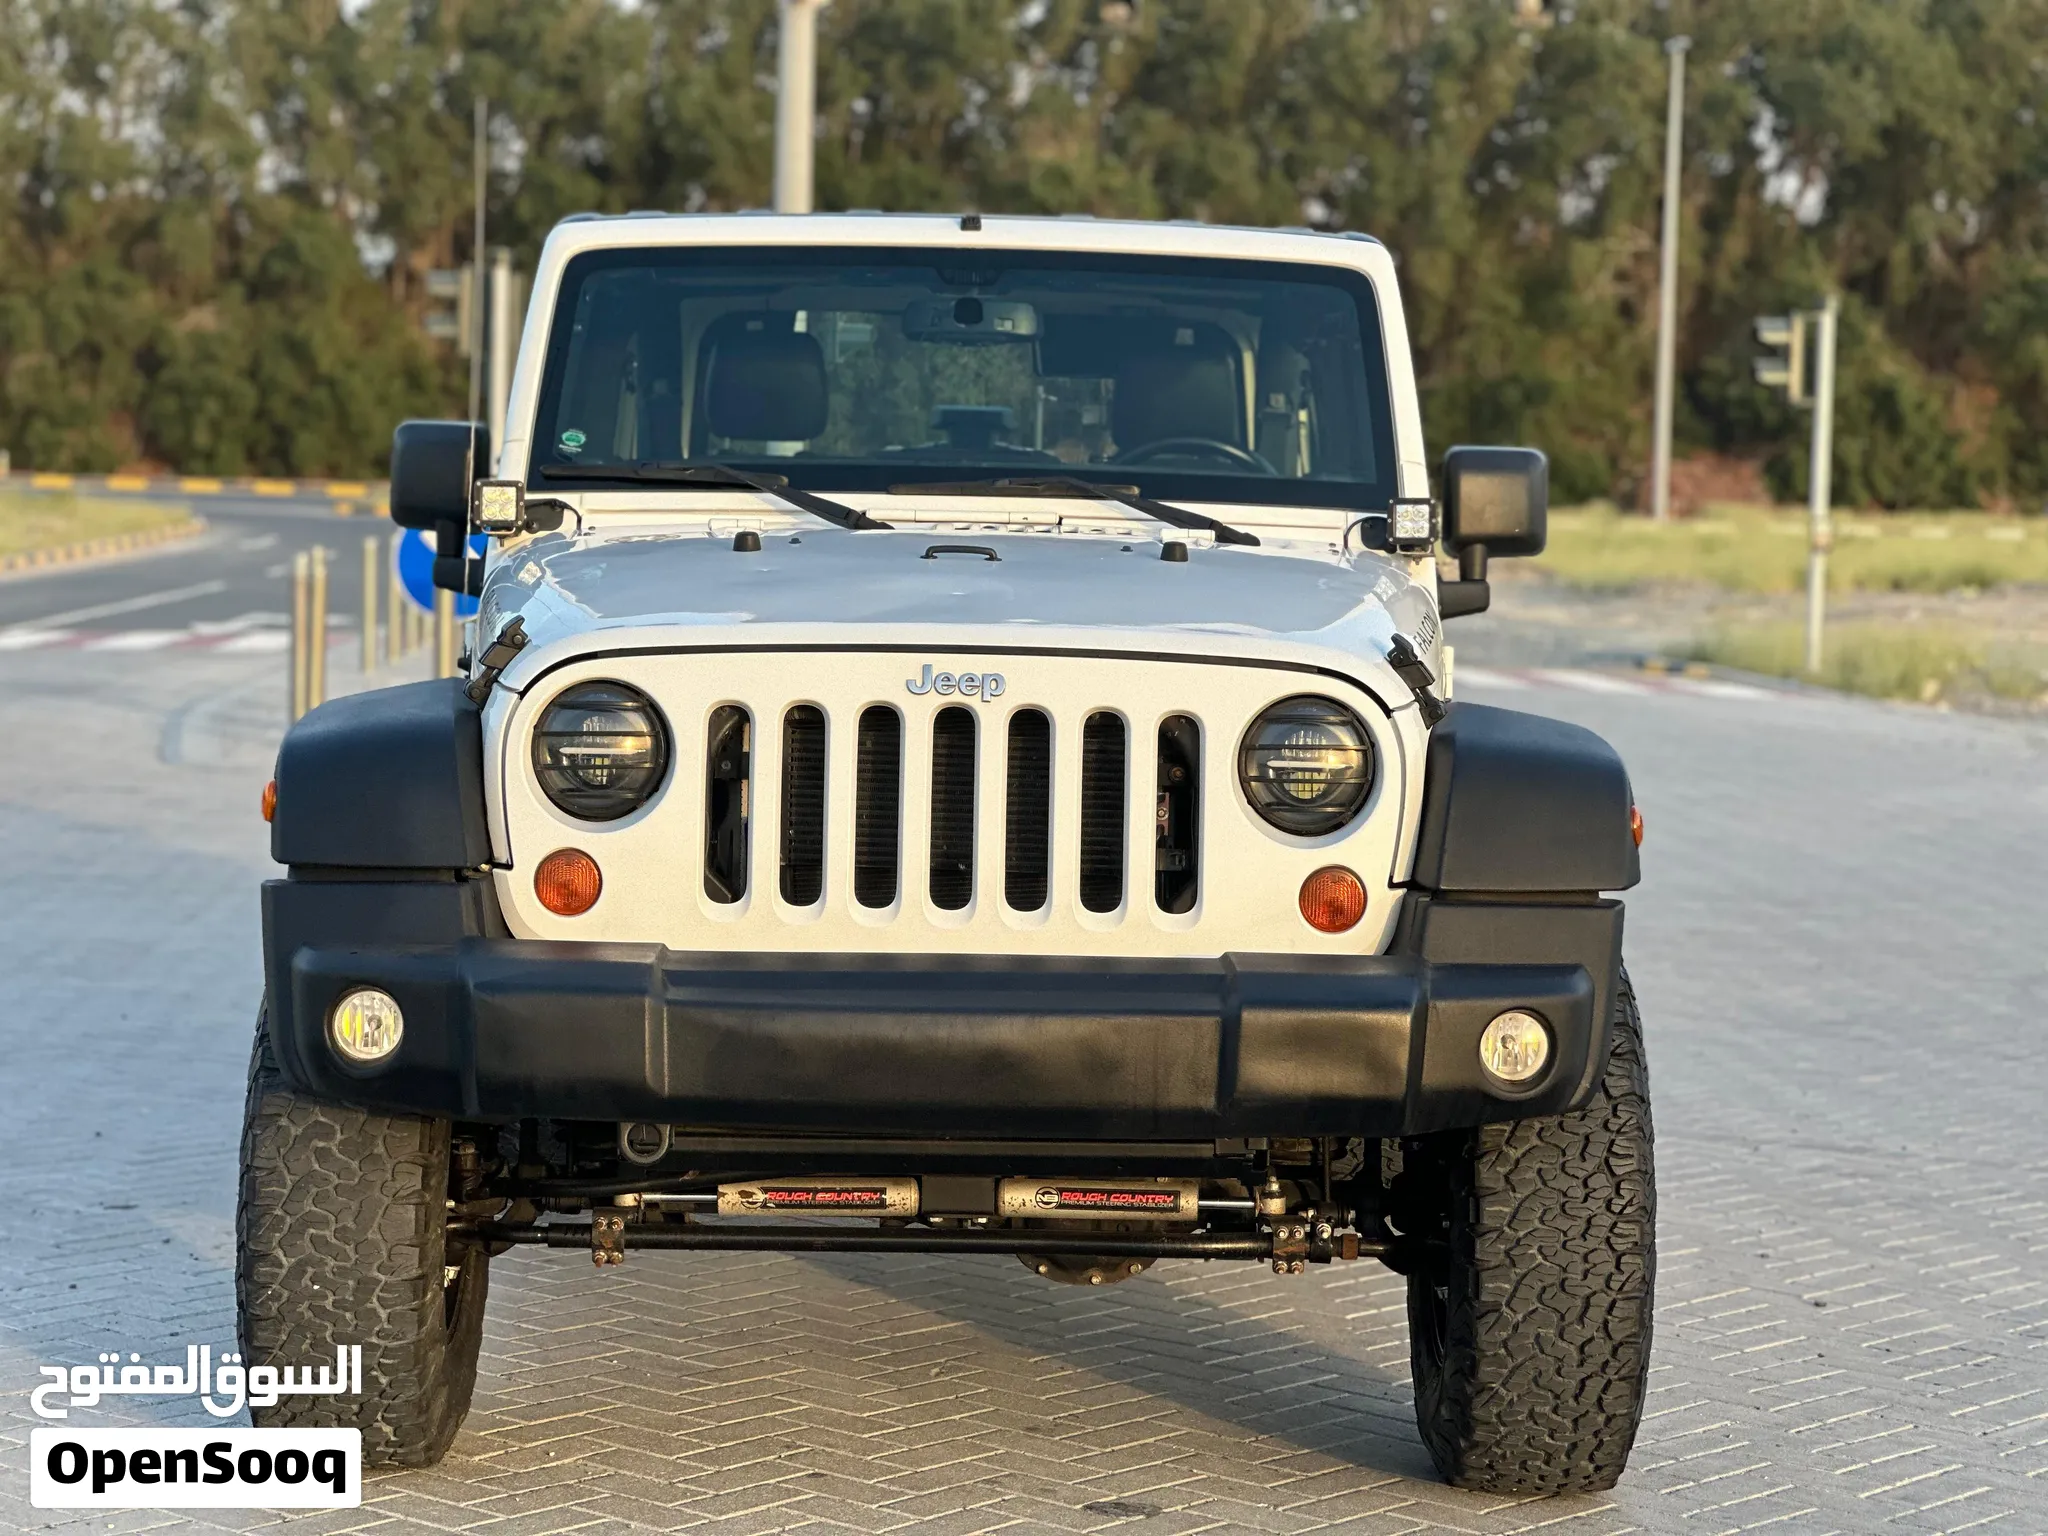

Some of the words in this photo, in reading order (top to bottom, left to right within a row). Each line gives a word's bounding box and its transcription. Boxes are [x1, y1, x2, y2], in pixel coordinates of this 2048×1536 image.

[906, 663, 1006, 703] Jeep
[767, 1192, 813, 1201] ROUGH
[815, 1192, 880, 1201] COUNTRY
[1061, 1192, 1107, 1202] ROUGH
[1110, 1194, 1174, 1204] COUNTRY
[1096, 1200, 1132, 1208] STEERING
